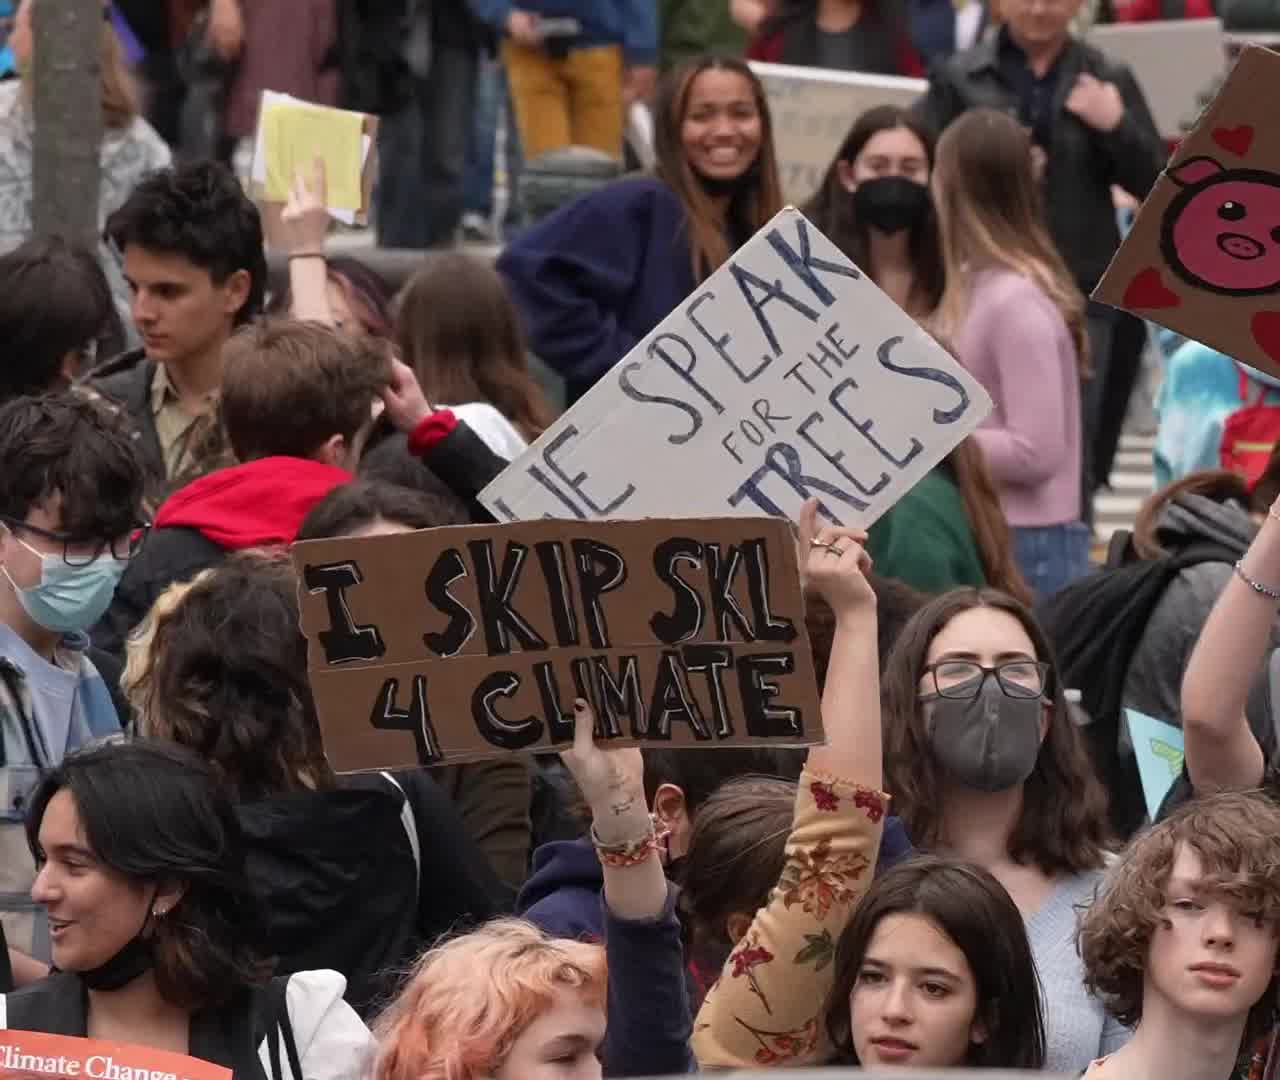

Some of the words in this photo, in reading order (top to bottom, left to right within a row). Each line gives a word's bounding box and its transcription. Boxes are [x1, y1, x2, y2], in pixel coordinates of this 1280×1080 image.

[618, 219, 860, 445] SPEAK
[721, 398, 792, 464] FOR
[783, 323, 860, 394] THE
[727, 335, 971, 528] TREES
[303, 558, 386, 664] I
[422, 538, 628, 659] SKIP
[649, 536, 799, 644] SKL
[369, 672, 444, 764] 4
[470, 647, 804, 750] CLIMATE
[0, 1043, 82, 1077] limate
